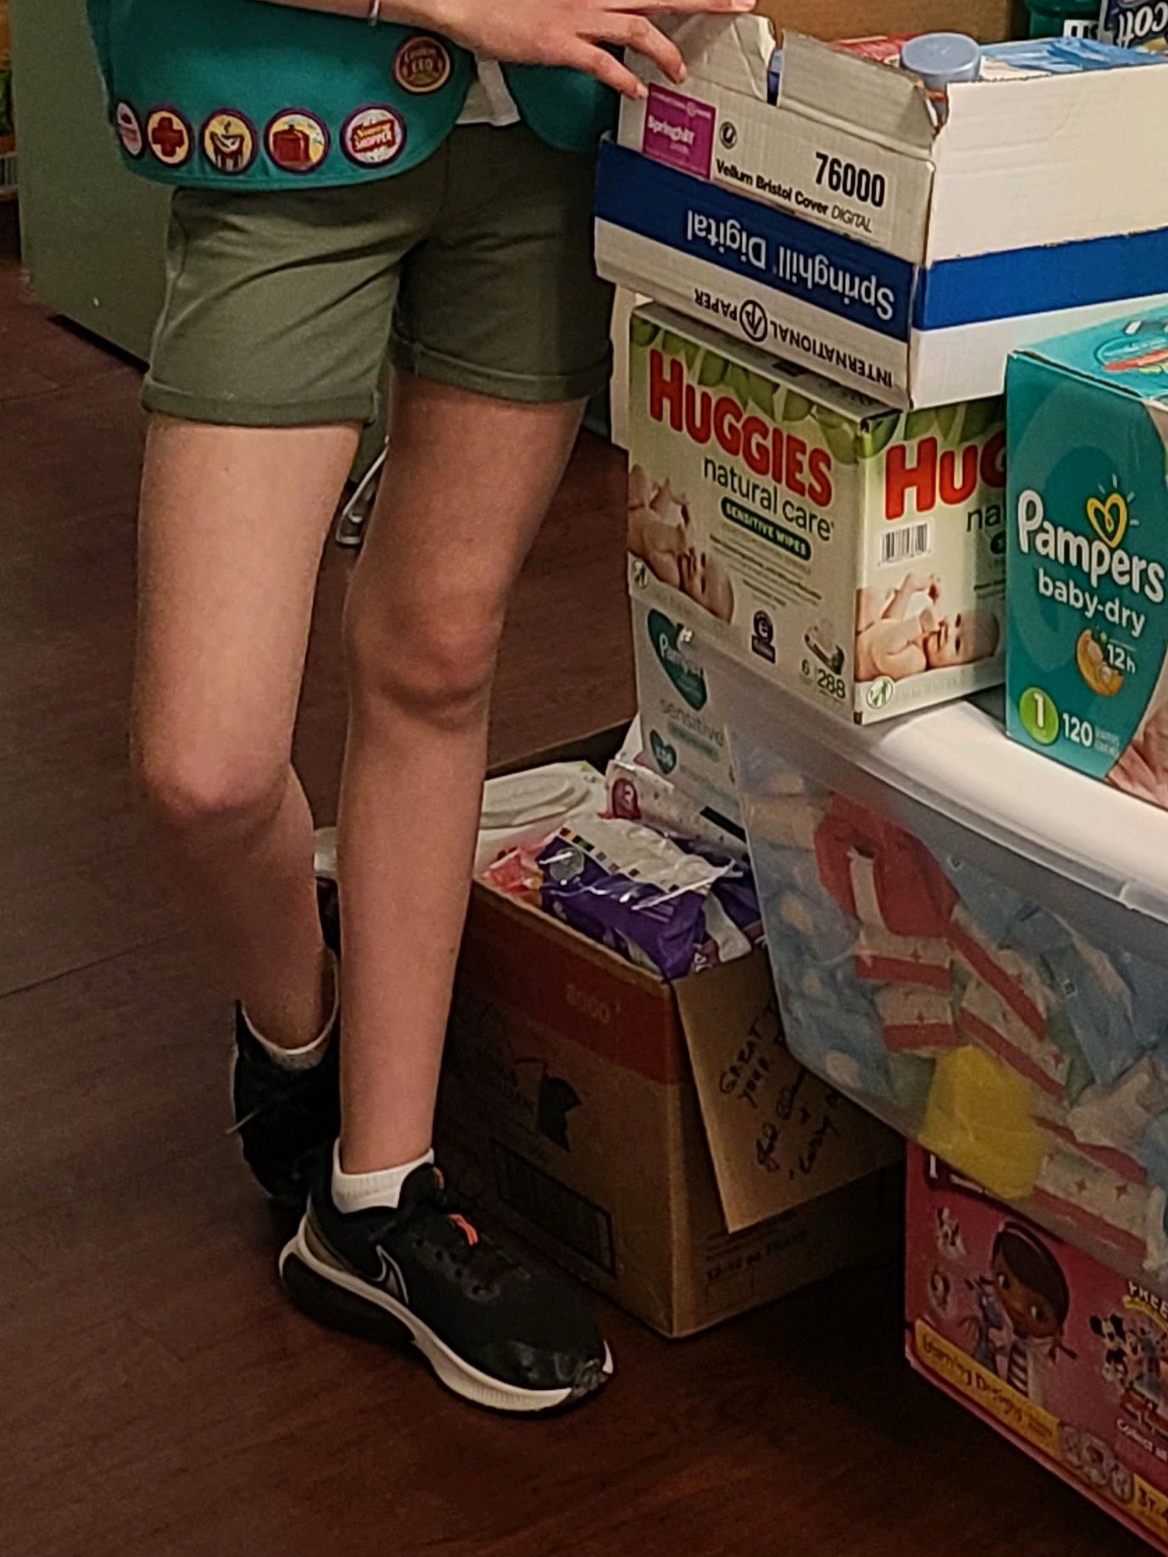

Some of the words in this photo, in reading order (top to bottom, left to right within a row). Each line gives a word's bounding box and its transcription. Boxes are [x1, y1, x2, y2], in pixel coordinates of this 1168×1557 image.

[647, 115, 695, 146] Springhill
[715, 158, 754, 186] Vellum
[755, 175, 792, 202] Bristol
[794, 190, 829, 216] Cover
[830, 204, 874, 234] DIGITAL
[814, 151, 887, 209] 76000
[687, 209, 767, 271] Digital
[693, 287, 739, 322] PAPER
[778, 245, 895, 321] Springhill
[769, 319, 893, 389] INTERNATIONAL
[648, 347, 833, 508] HUGGIES
[703, 456, 778, 515] natural
[781, 499, 831, 542] care
[725, 501, 775, 539] SENSITIVE
[775, 528, 807, 557] WIPES
[1017, 488, 1166, 604] Pampers
[1038, 567, 1147, 639] baby-dry
[802, 658, 811, 677] 6
[816, 667, 847, 700] 288
[1106, 643, 1136, 675] 12h
[1034, 692, 1046, 729] 1
[1062, 712, 1094, 748] 120
